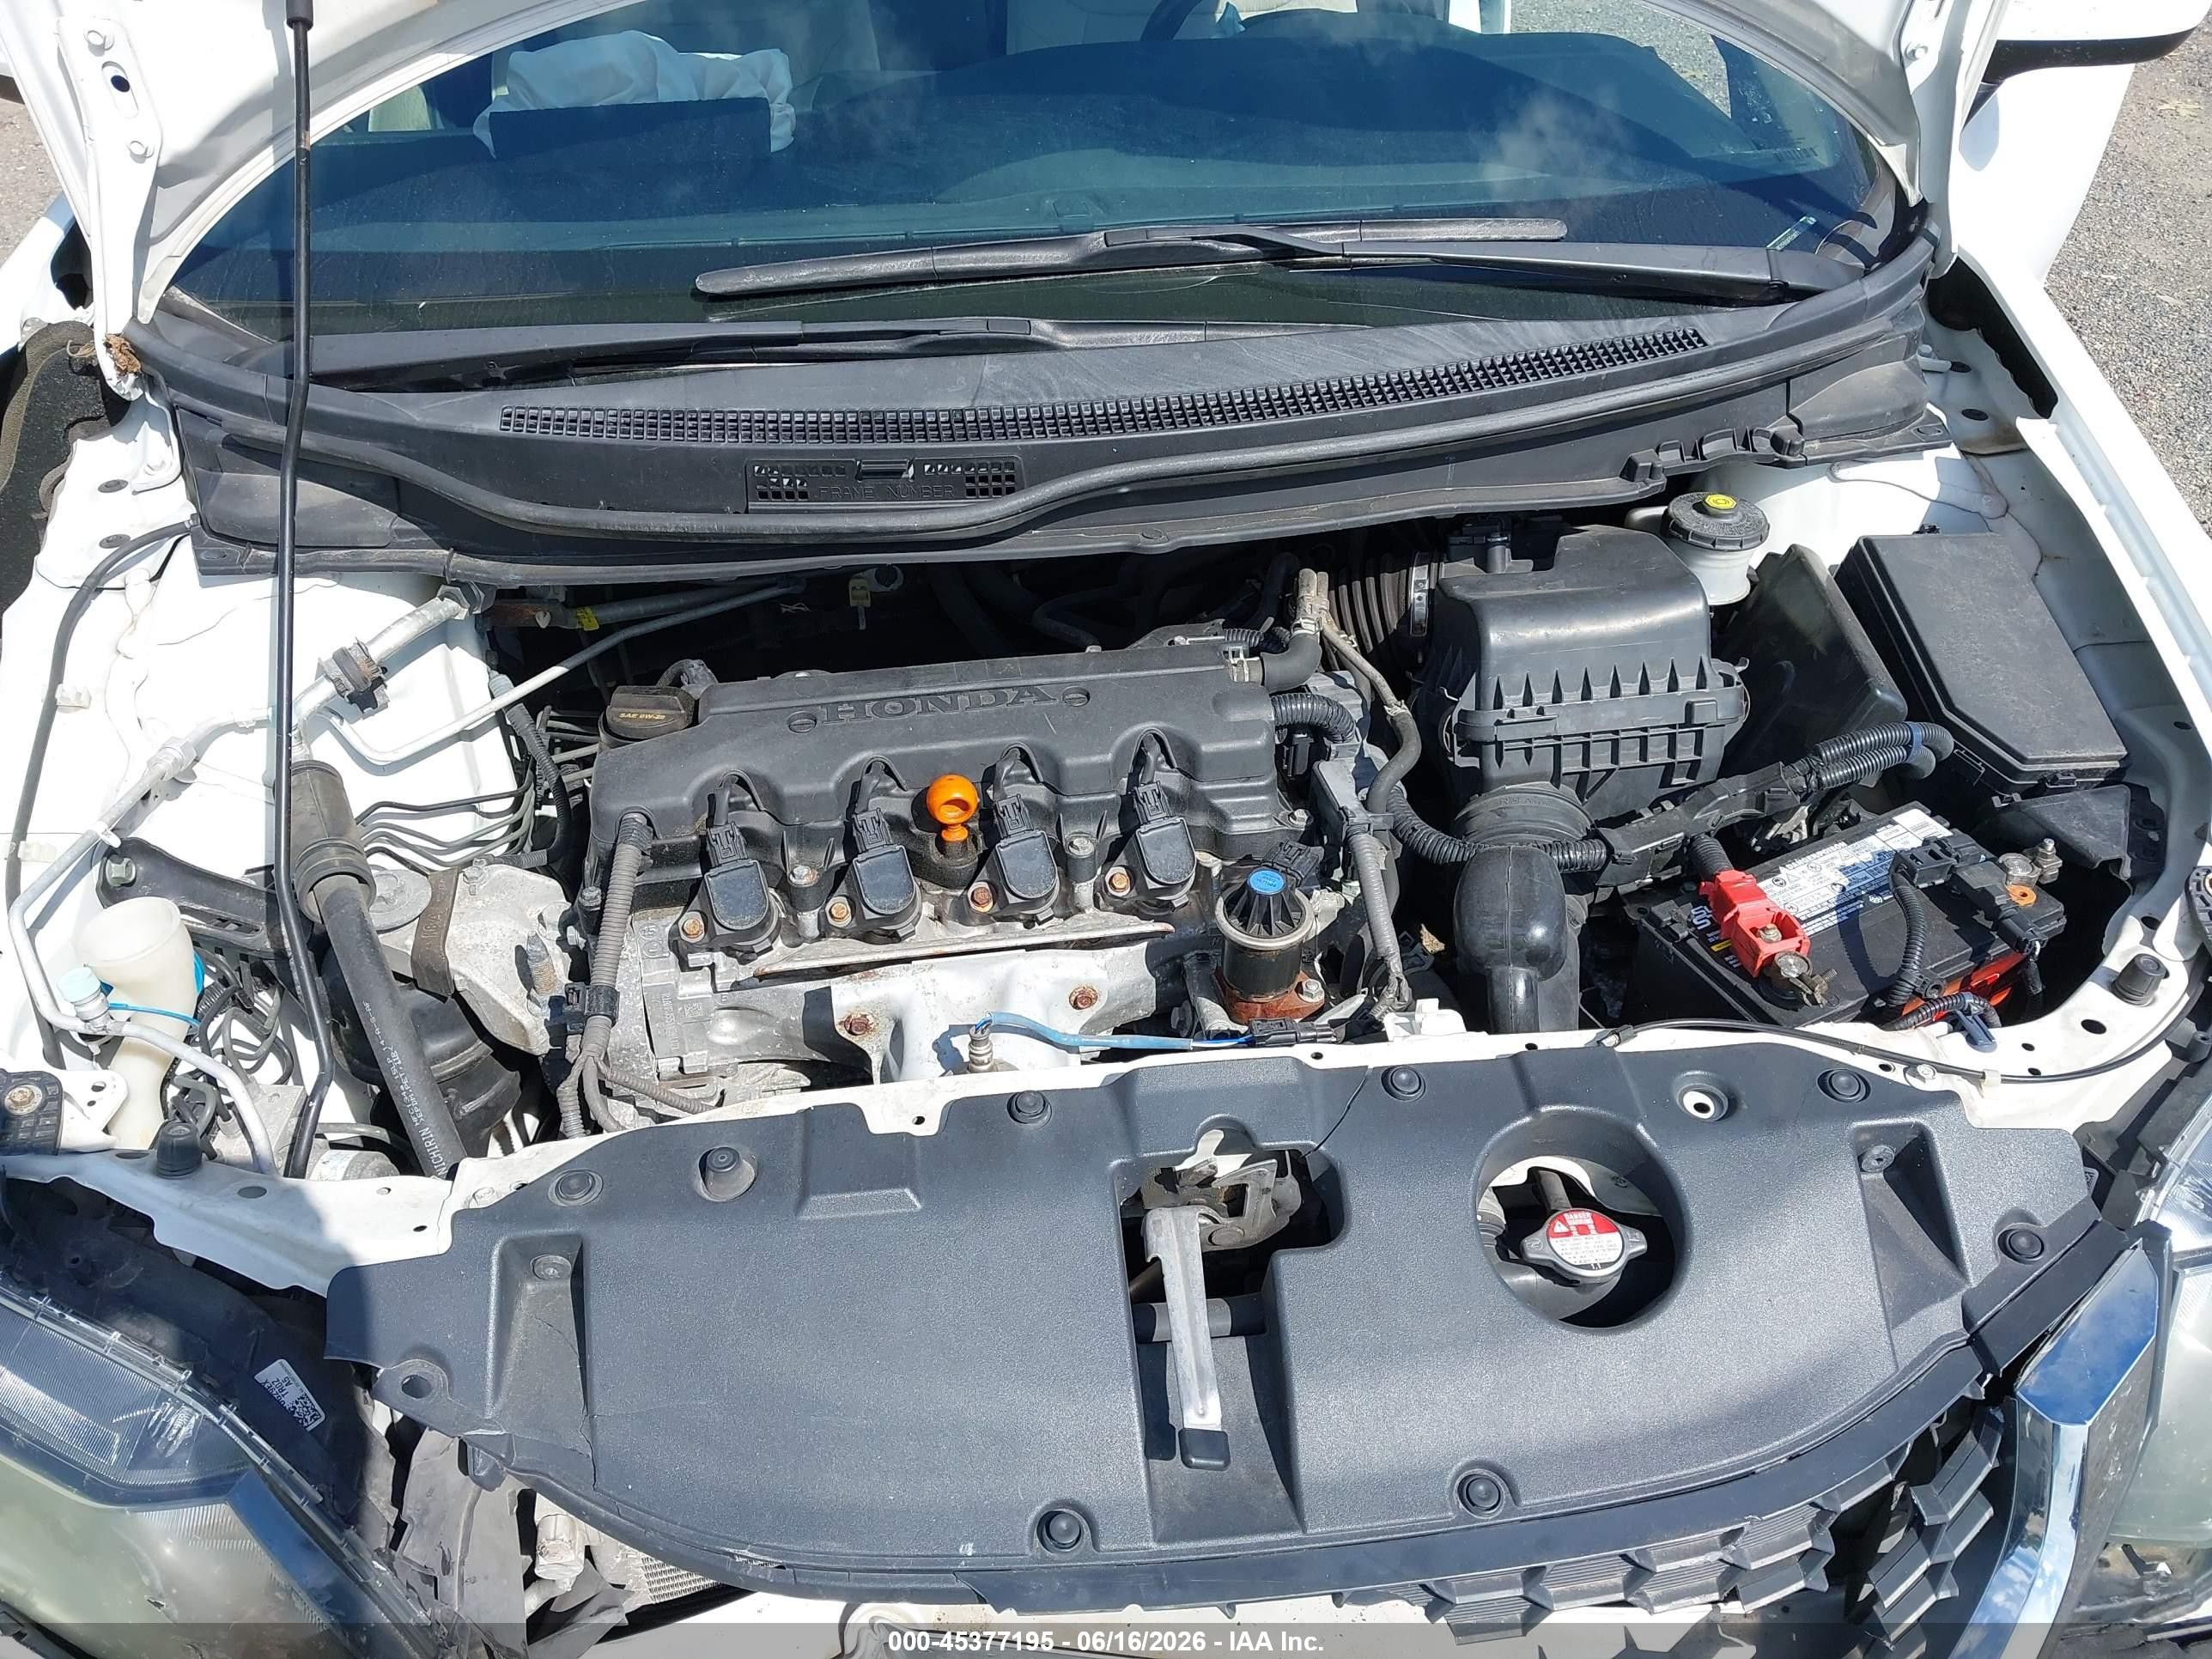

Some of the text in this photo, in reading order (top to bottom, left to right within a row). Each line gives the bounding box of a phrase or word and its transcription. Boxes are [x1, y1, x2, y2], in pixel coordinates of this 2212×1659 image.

[817, 483, 954, 500] FRAME NUMBER
[822, 686, 1056, 725] HONDA
[418, 1127, 448, 1181] NICHIRIN
